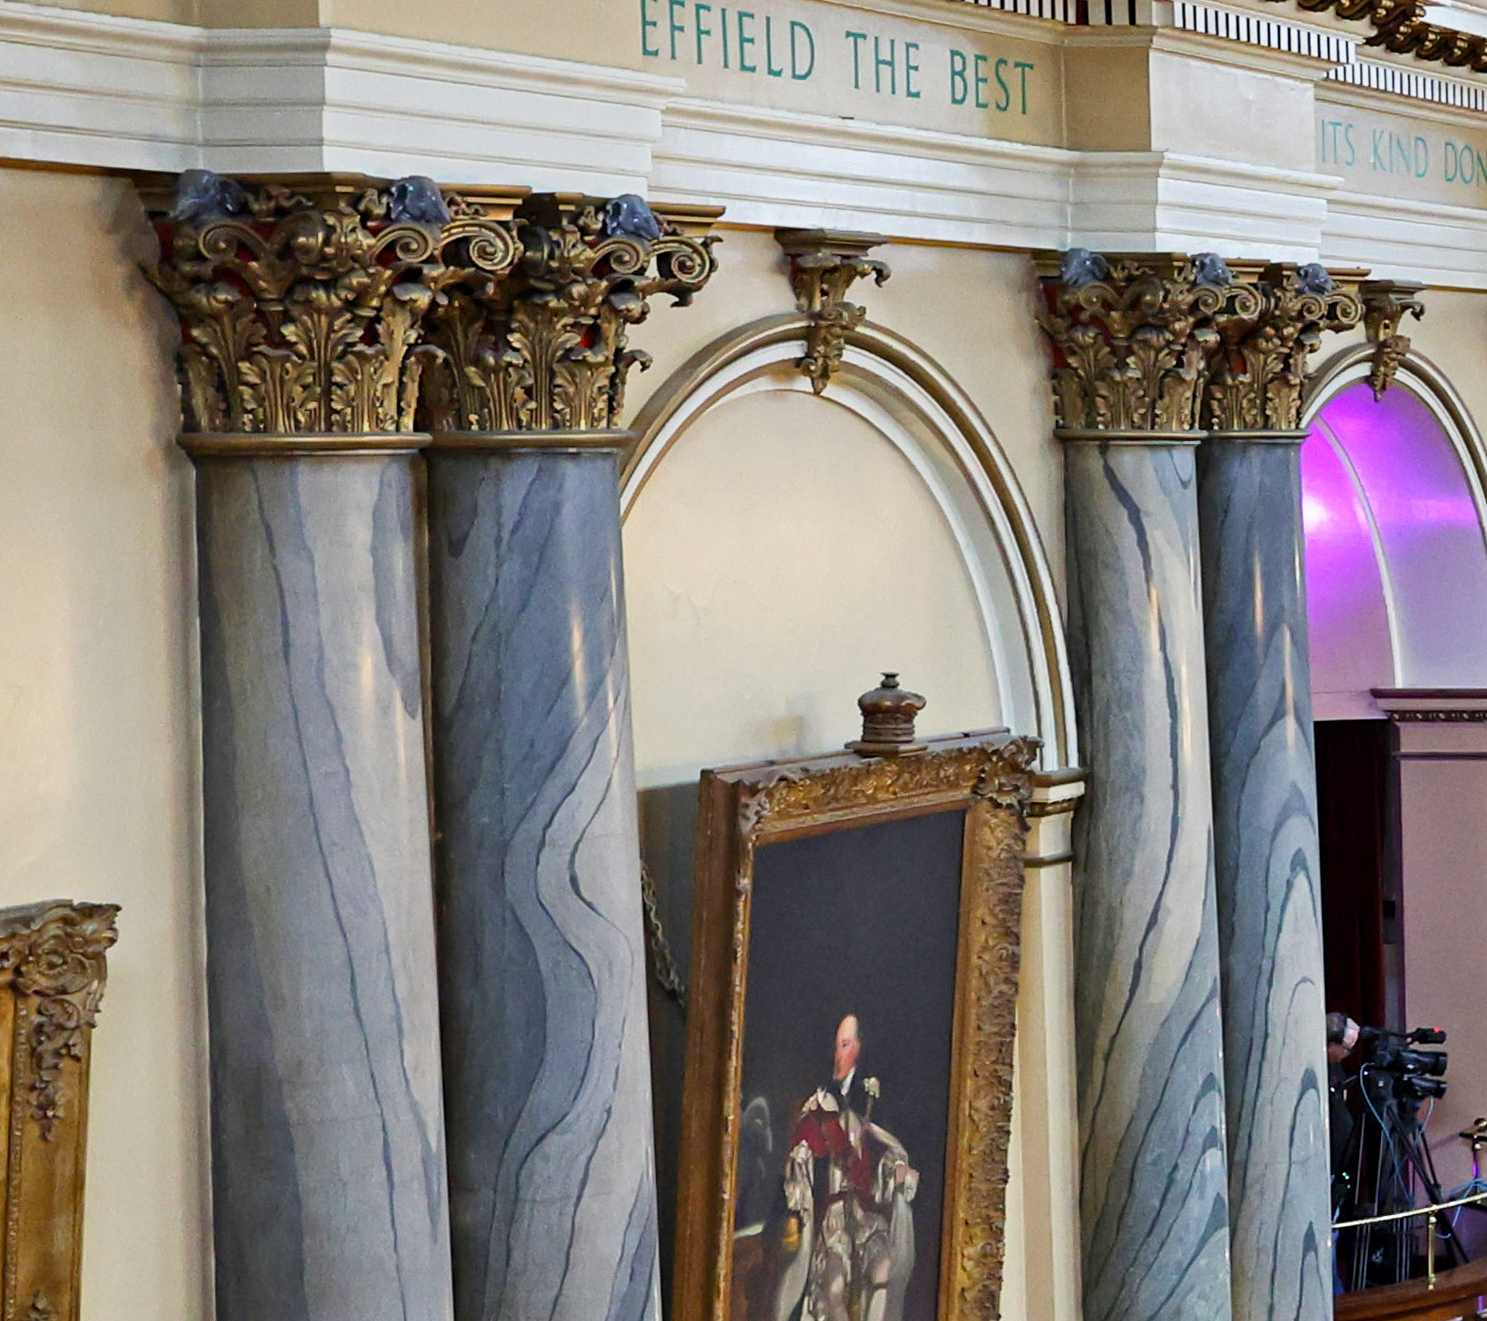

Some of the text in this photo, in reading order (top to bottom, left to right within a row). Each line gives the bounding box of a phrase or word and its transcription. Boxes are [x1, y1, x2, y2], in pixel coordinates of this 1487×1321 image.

[845, 30, 921, 99] THE
[949, 49, 1035, 116] BEST
[1321, 119, 1355, 167] ITS
[1372, 128, 1429, 179] KIND
